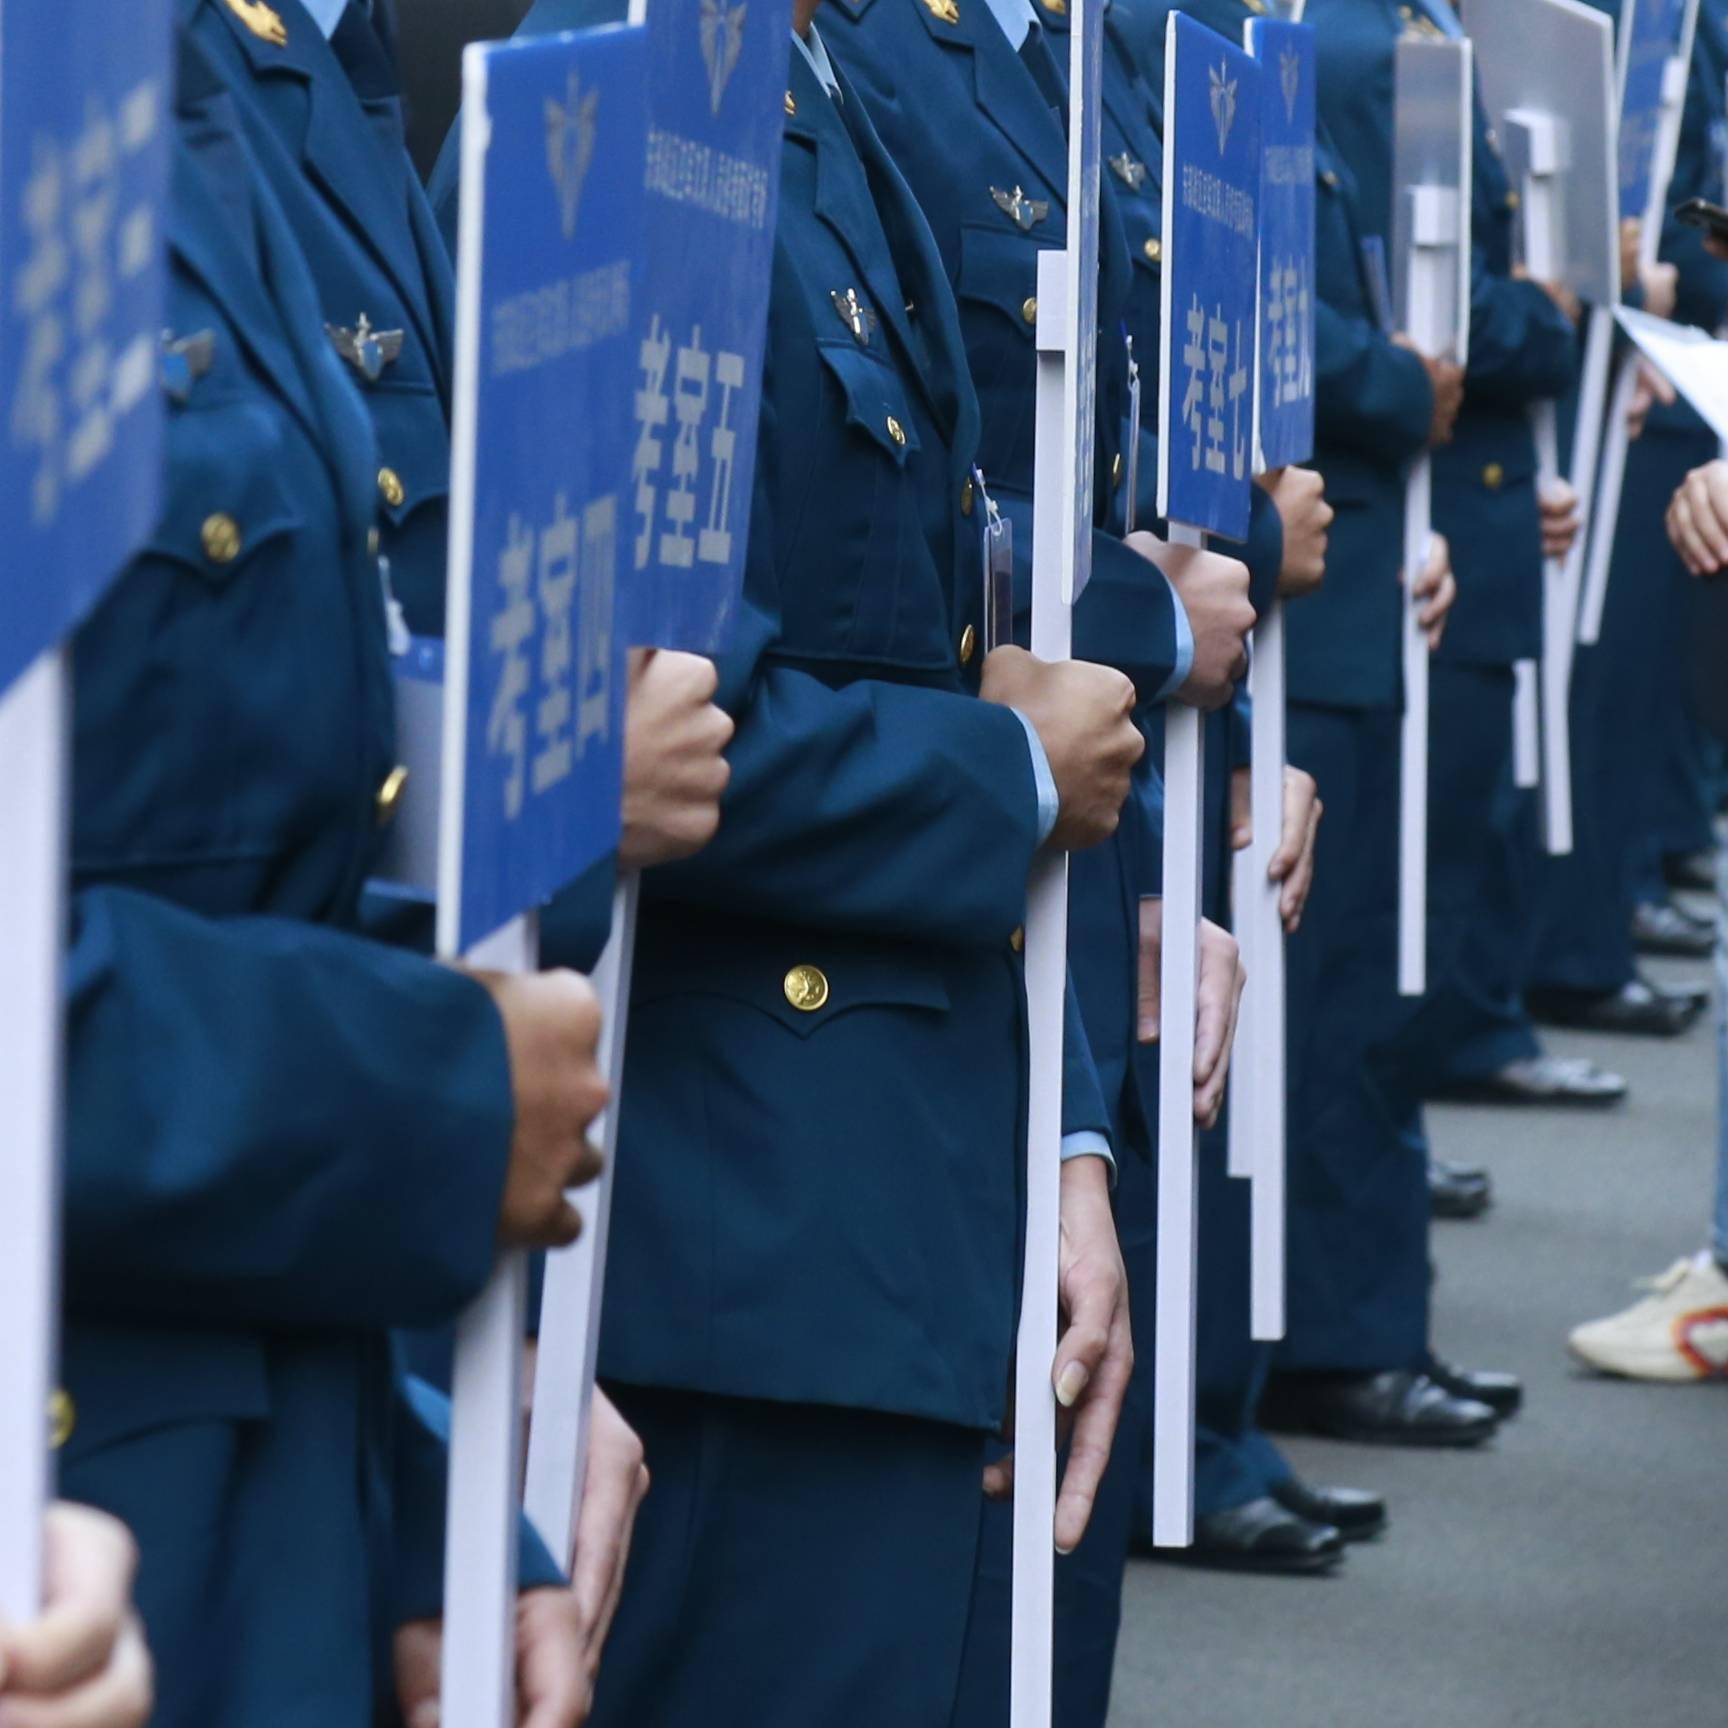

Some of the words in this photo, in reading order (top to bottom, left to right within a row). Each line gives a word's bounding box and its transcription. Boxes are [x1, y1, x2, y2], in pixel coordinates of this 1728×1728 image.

[632, 314, 746, 570] 考室五
[1181, 292, 1249, 483] 考室七
[486, 488, 618, 822] 考室四
